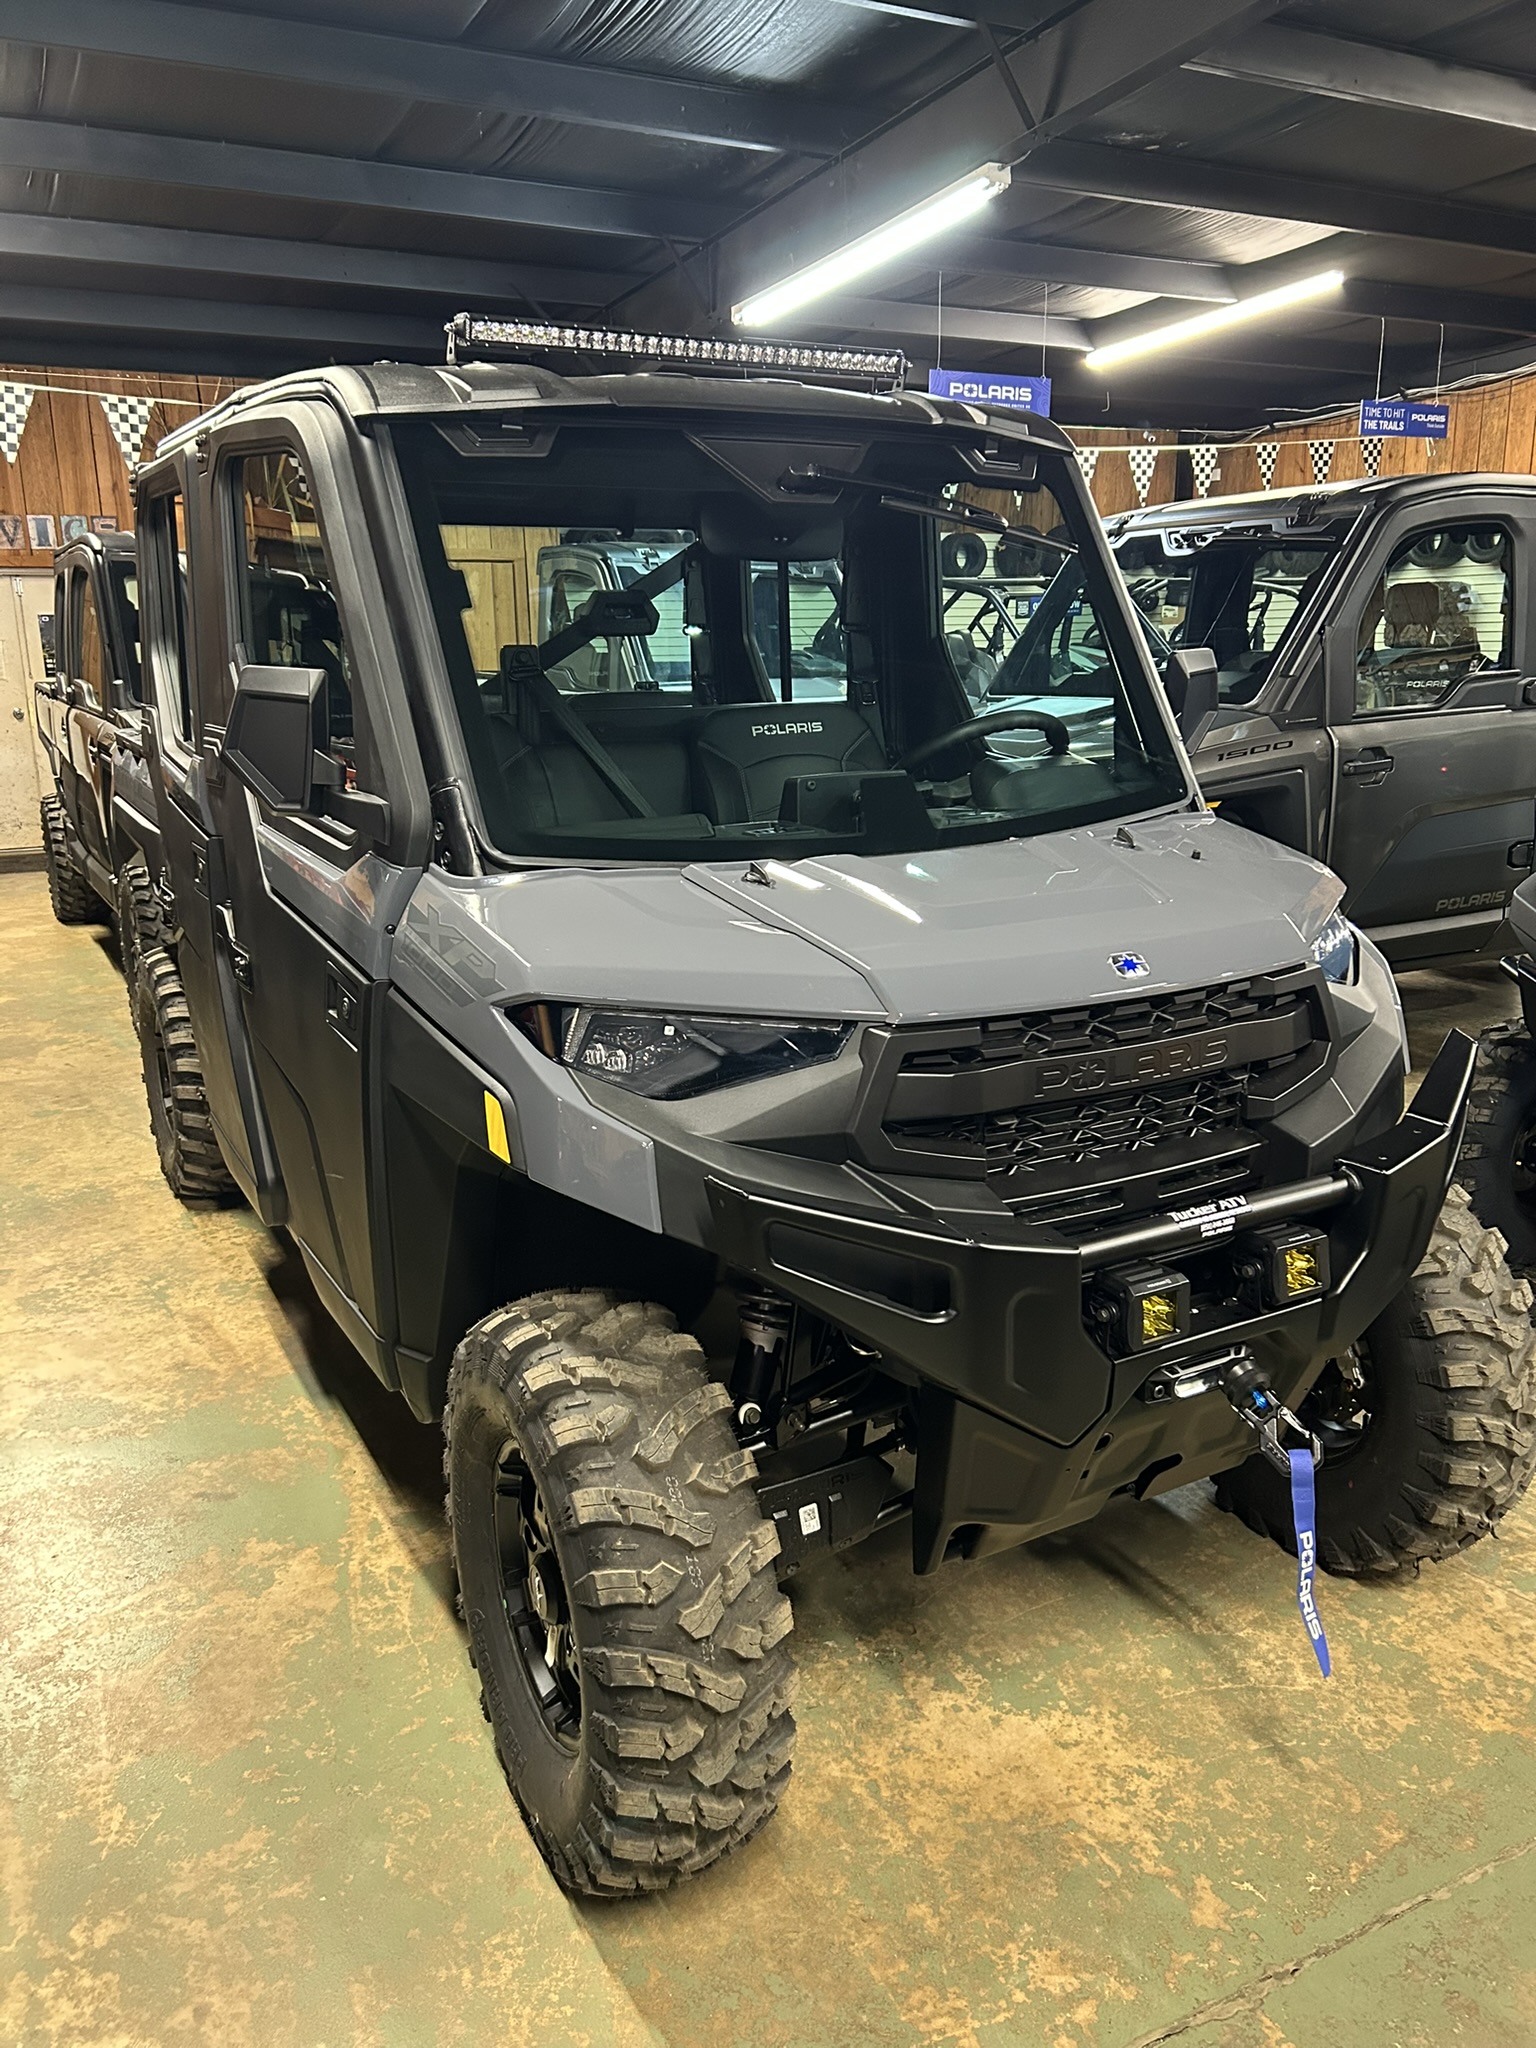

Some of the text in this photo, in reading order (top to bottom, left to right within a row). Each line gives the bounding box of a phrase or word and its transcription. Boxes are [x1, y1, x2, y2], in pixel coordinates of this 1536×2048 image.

[949, 382, 1032, 402] POLARIS
[1364, 406, 1405, 419] TIME TO HIT
[1411, 413, 1446, 423] POLARIS
[1363, 419, 1405, 431] THE TRAILS
[1406, 680, 1450, 688] POLARIS
[751, 722, 823, 737] POLARIS
[1217, 740, 1294, 762] 1500
[1435, 890, 1506, 912] POLARIS
[407, 902, 497, 979] XP
[1034, 1033, 1229, 1098] POLARIS
[1166, 1203, 1218, 1222] Tucker
[1218, 1195, 1247, 1211] ATV
[1299, 1530, 1323, 1640] POLARIS
